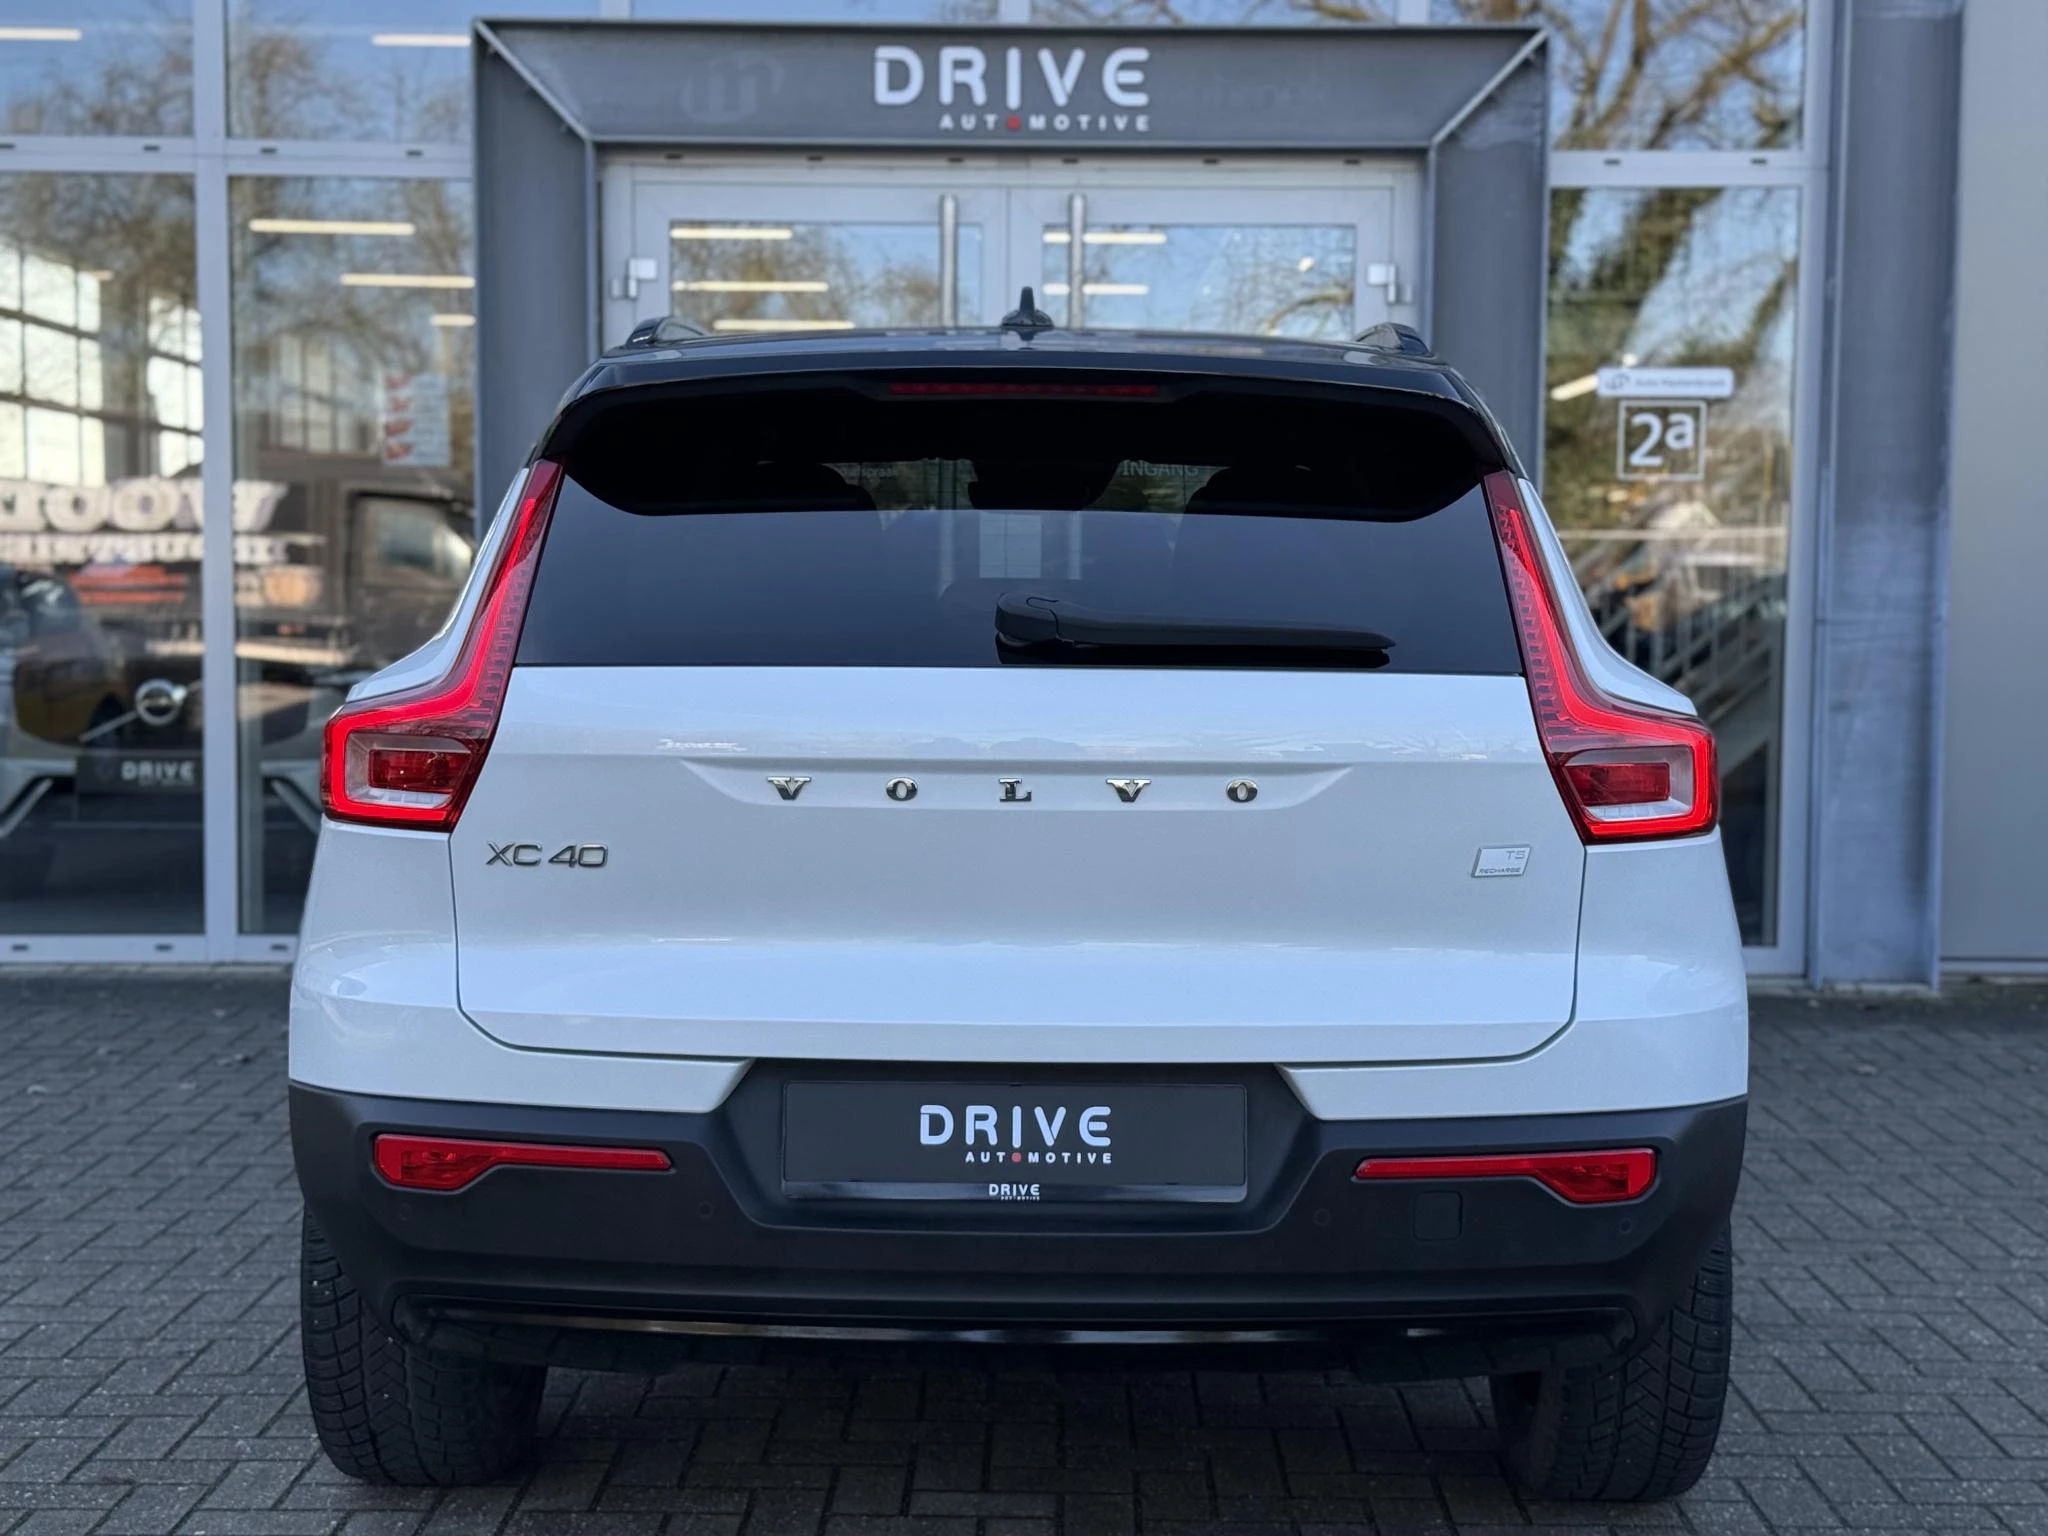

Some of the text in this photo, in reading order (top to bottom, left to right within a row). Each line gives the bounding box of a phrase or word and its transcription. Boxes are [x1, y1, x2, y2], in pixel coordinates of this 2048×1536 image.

[874, 46, 1150, 110] DRIVE
[940, 114, 1150, 131] AUTOMOTIVE
[1629, 412, 1695, 466] 2a
[1122, 460, 1199, 476] INGANG
[121, 761, 195, 781] DRIVE
[767, 776, 1258, 803] VOLVO
[920, 1104, 1112, 1148] DRIVE
[965, 1152, 1112, 1164] AUTOMOTIVE
[989, 1184, 1040, 1196] DRIVE
